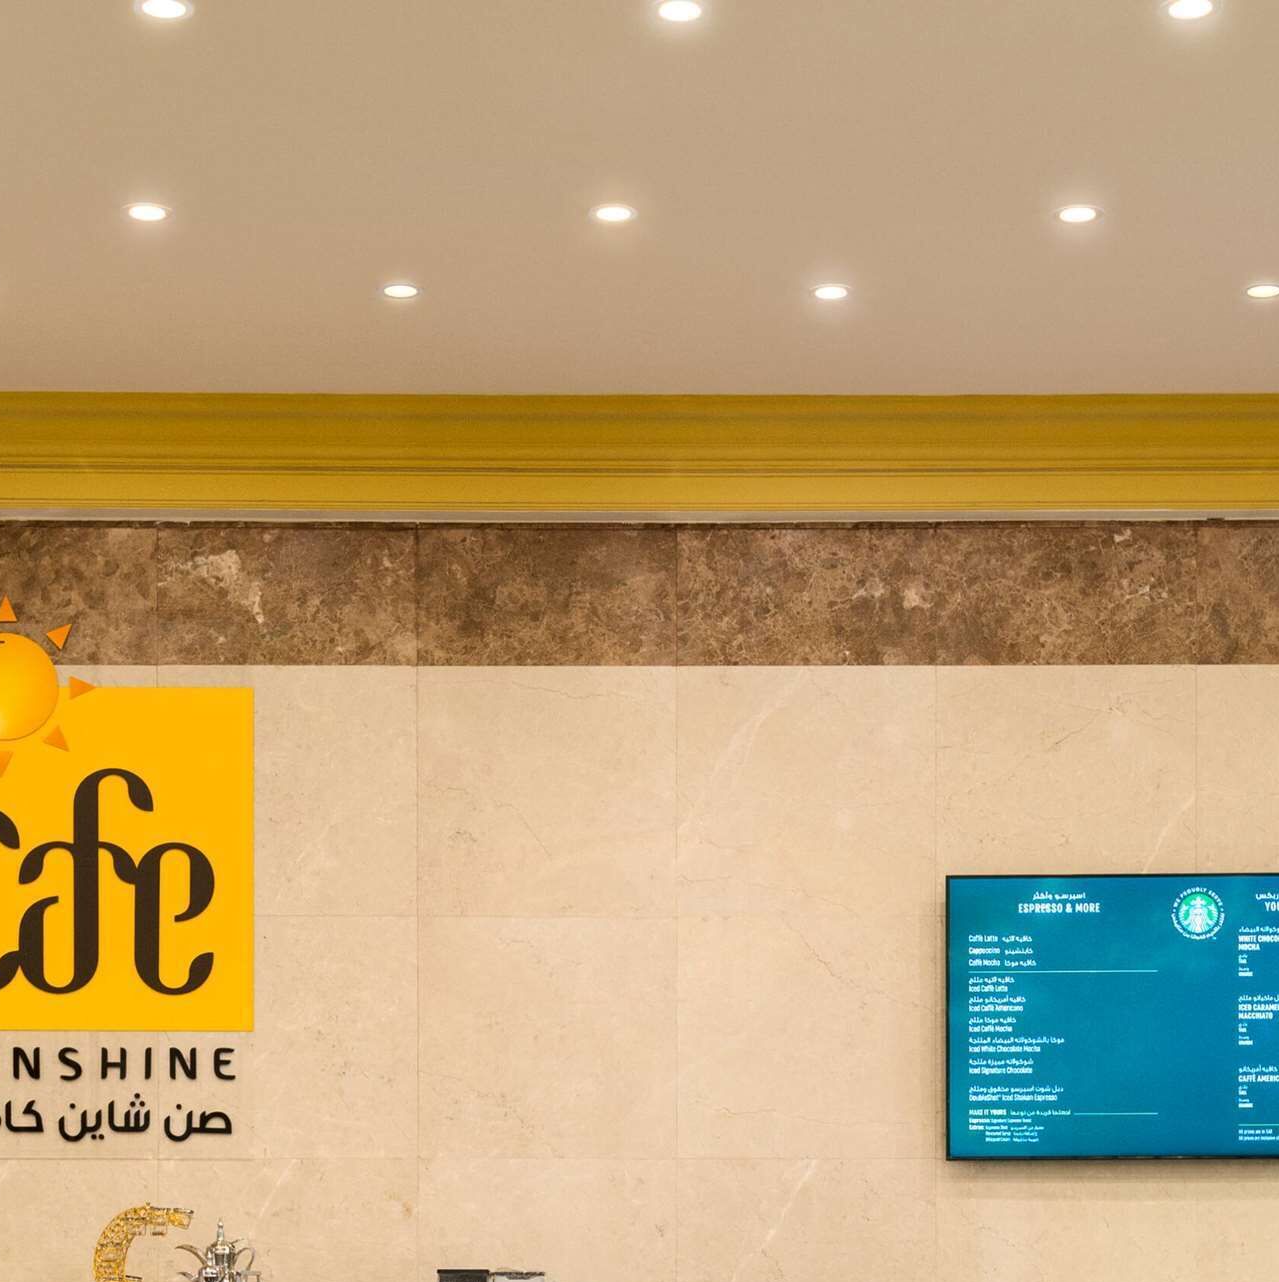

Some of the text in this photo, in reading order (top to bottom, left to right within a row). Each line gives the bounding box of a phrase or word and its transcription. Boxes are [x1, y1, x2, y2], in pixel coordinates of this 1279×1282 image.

[1180, 886, 1207, 898] PROUDLY
[1018, 902, 1101, 914] ESPRESSO & MORE
[984, 934, 998, 942] Latte
[1238, 935, 1257, 943] WHITE
[968, 947, 1001, 955] Cappuccino
[1238, 943, 1260, 951] MOCHA
[983, 959, 1001, 967] Mocha
[1238, 1003, 1252, 1011] ICED
[1238, 1011, 1273, 1020] MACCHIATO
[58, 1092, 151, 1143] شاين
[163, 1102, 233, 1142] صن
